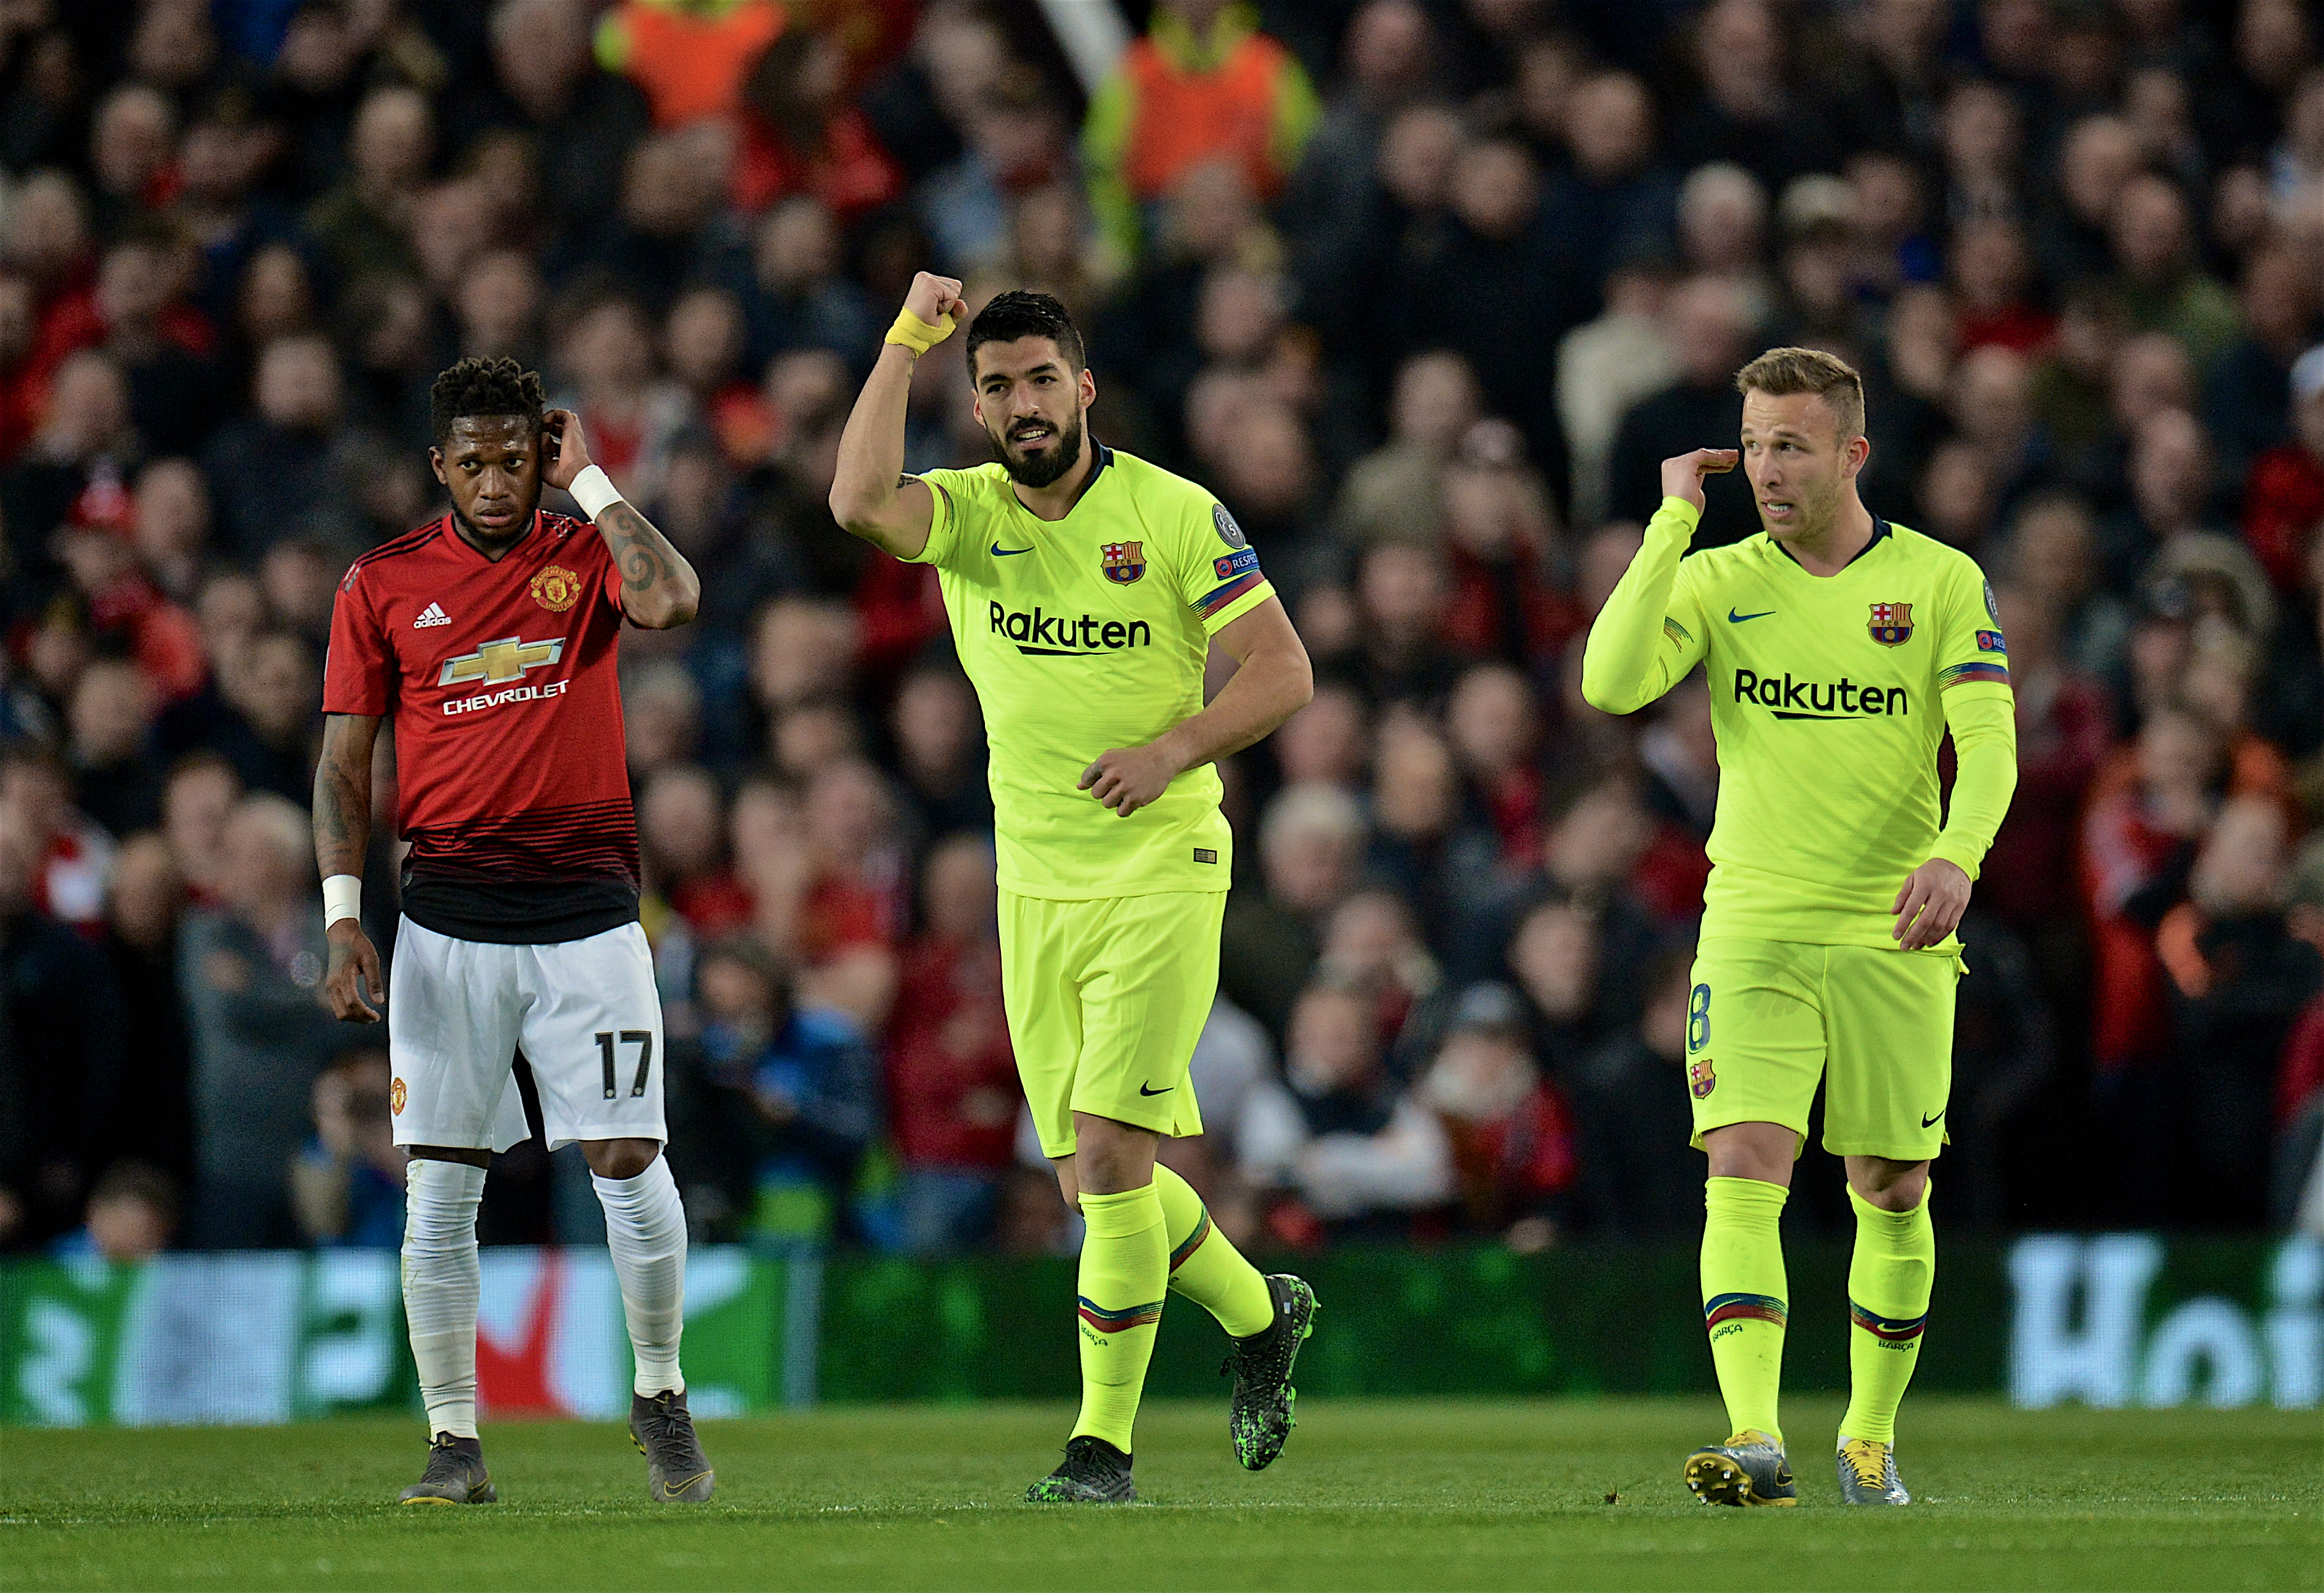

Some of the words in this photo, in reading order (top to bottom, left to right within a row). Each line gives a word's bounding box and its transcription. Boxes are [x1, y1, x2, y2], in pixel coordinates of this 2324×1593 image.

[1228, 524, 1237, 537] 5
[413, 617, 452, 629] adidas
[990, 600, 1151, 649] Rakuten
[443, 679, 570, 715] CHEVROLET
[1735, 669, 1907, 715] Rakuten
[1689, 983, 1711, 1054] 8
[595, 1030, 653, 1100] 17
